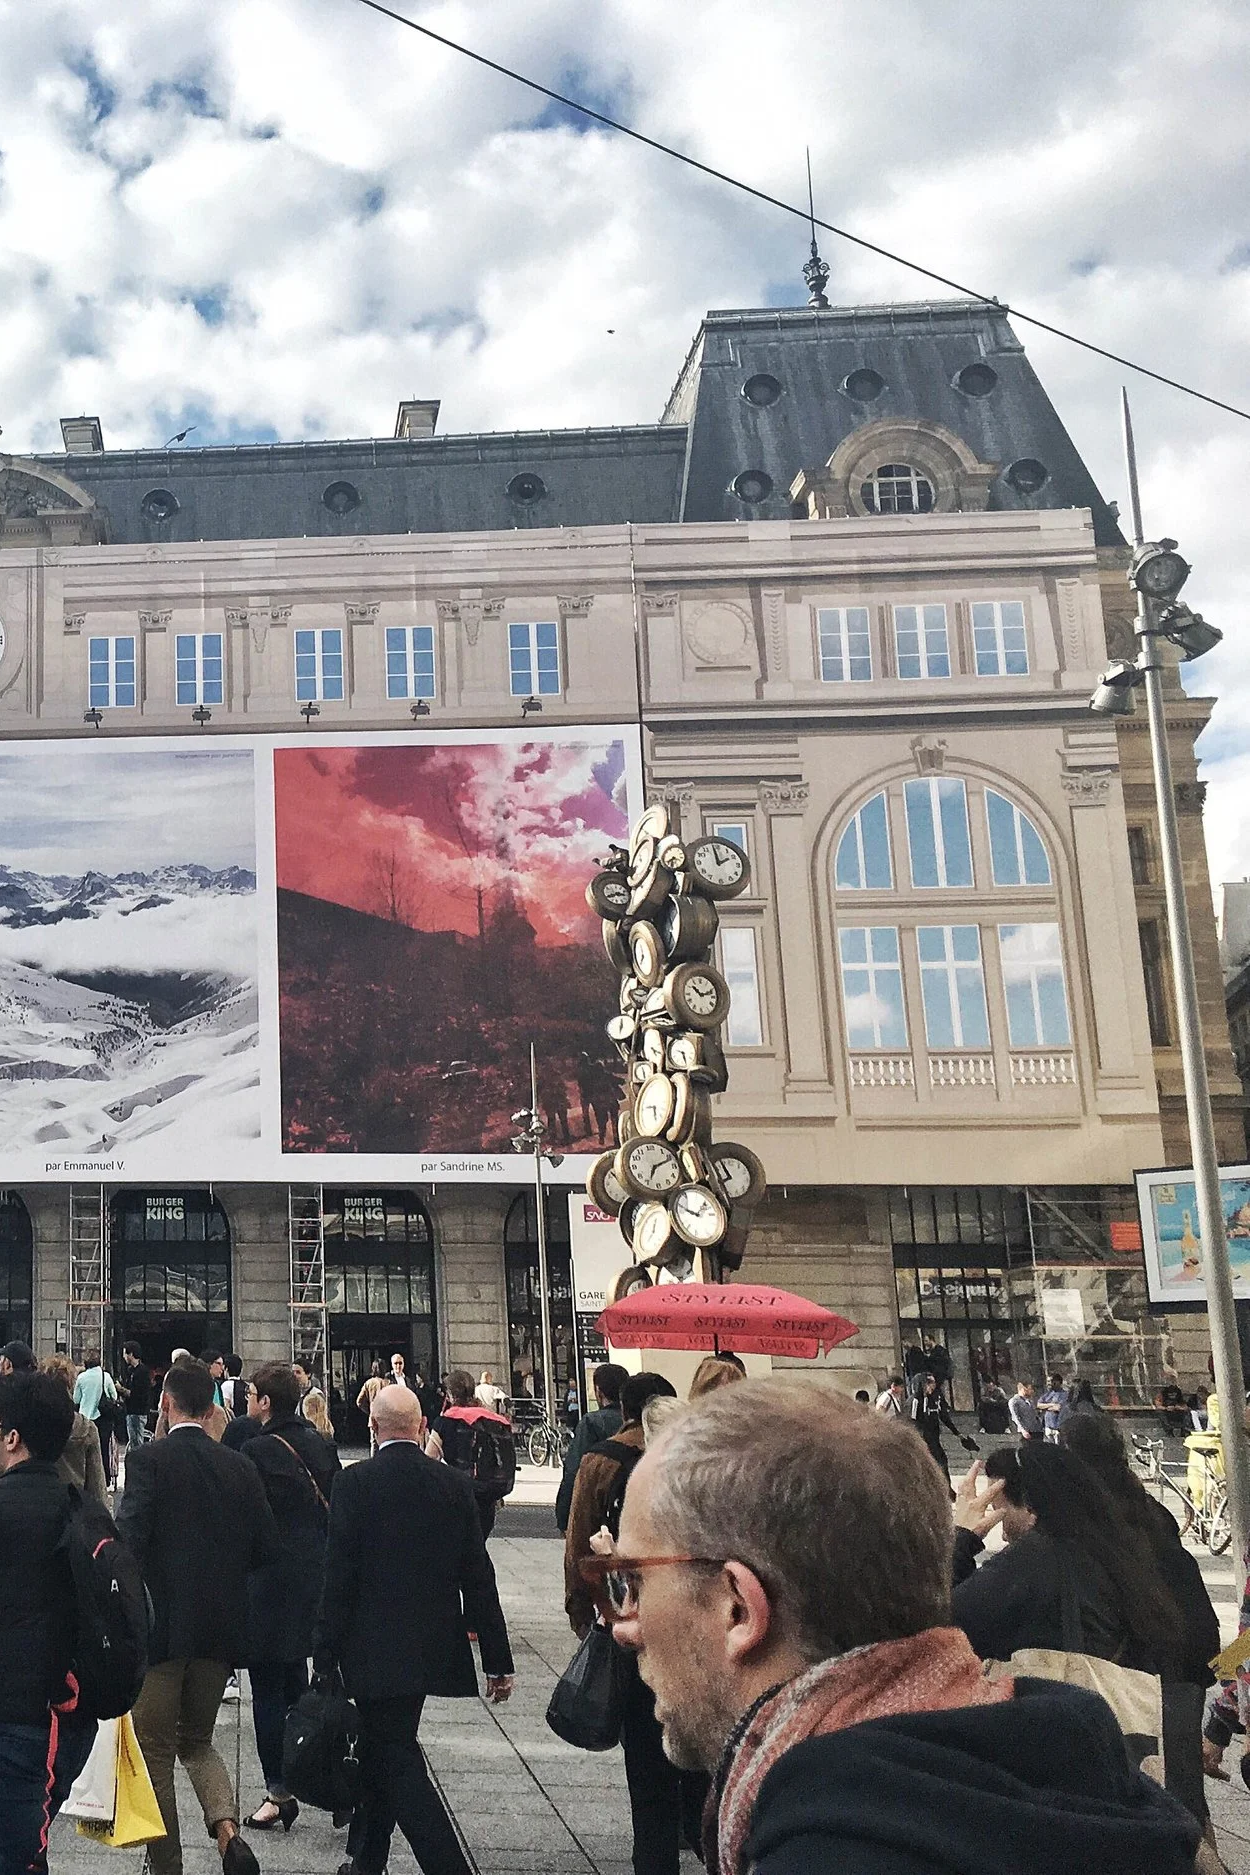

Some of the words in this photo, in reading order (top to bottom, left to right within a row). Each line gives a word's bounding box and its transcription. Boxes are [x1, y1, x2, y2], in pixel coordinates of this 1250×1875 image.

[45, 1162, 61, 1172] par
[64, 1161, 115, 1170] Emmanuel
[117, 1161, 126, 1170] V.
[421, 1163, 438, 1173] par
[440, 1161, 484, 1171] Sandrine
[487, 1162, 505, 1172] MS.
[146, 1197, 184, 1206] BURGER
[344, 1197, 383, 1207] BURGER
[146, 1207, 185, 1220] KING
[344, 1206, 384, 1221] KING
[586, 1210, 615, 1221] SNC
[579, 1291, 606, 1300] GARE
[661, 1293, 783, 1306] STYLIST
[580, 1300, 603, 1308] SAINT
[617, 1314, 670, 1326] STYLIST
[694, 1316, 747, 1328] STYLIST
[772, 1319, 830, 1333] STYLIST
